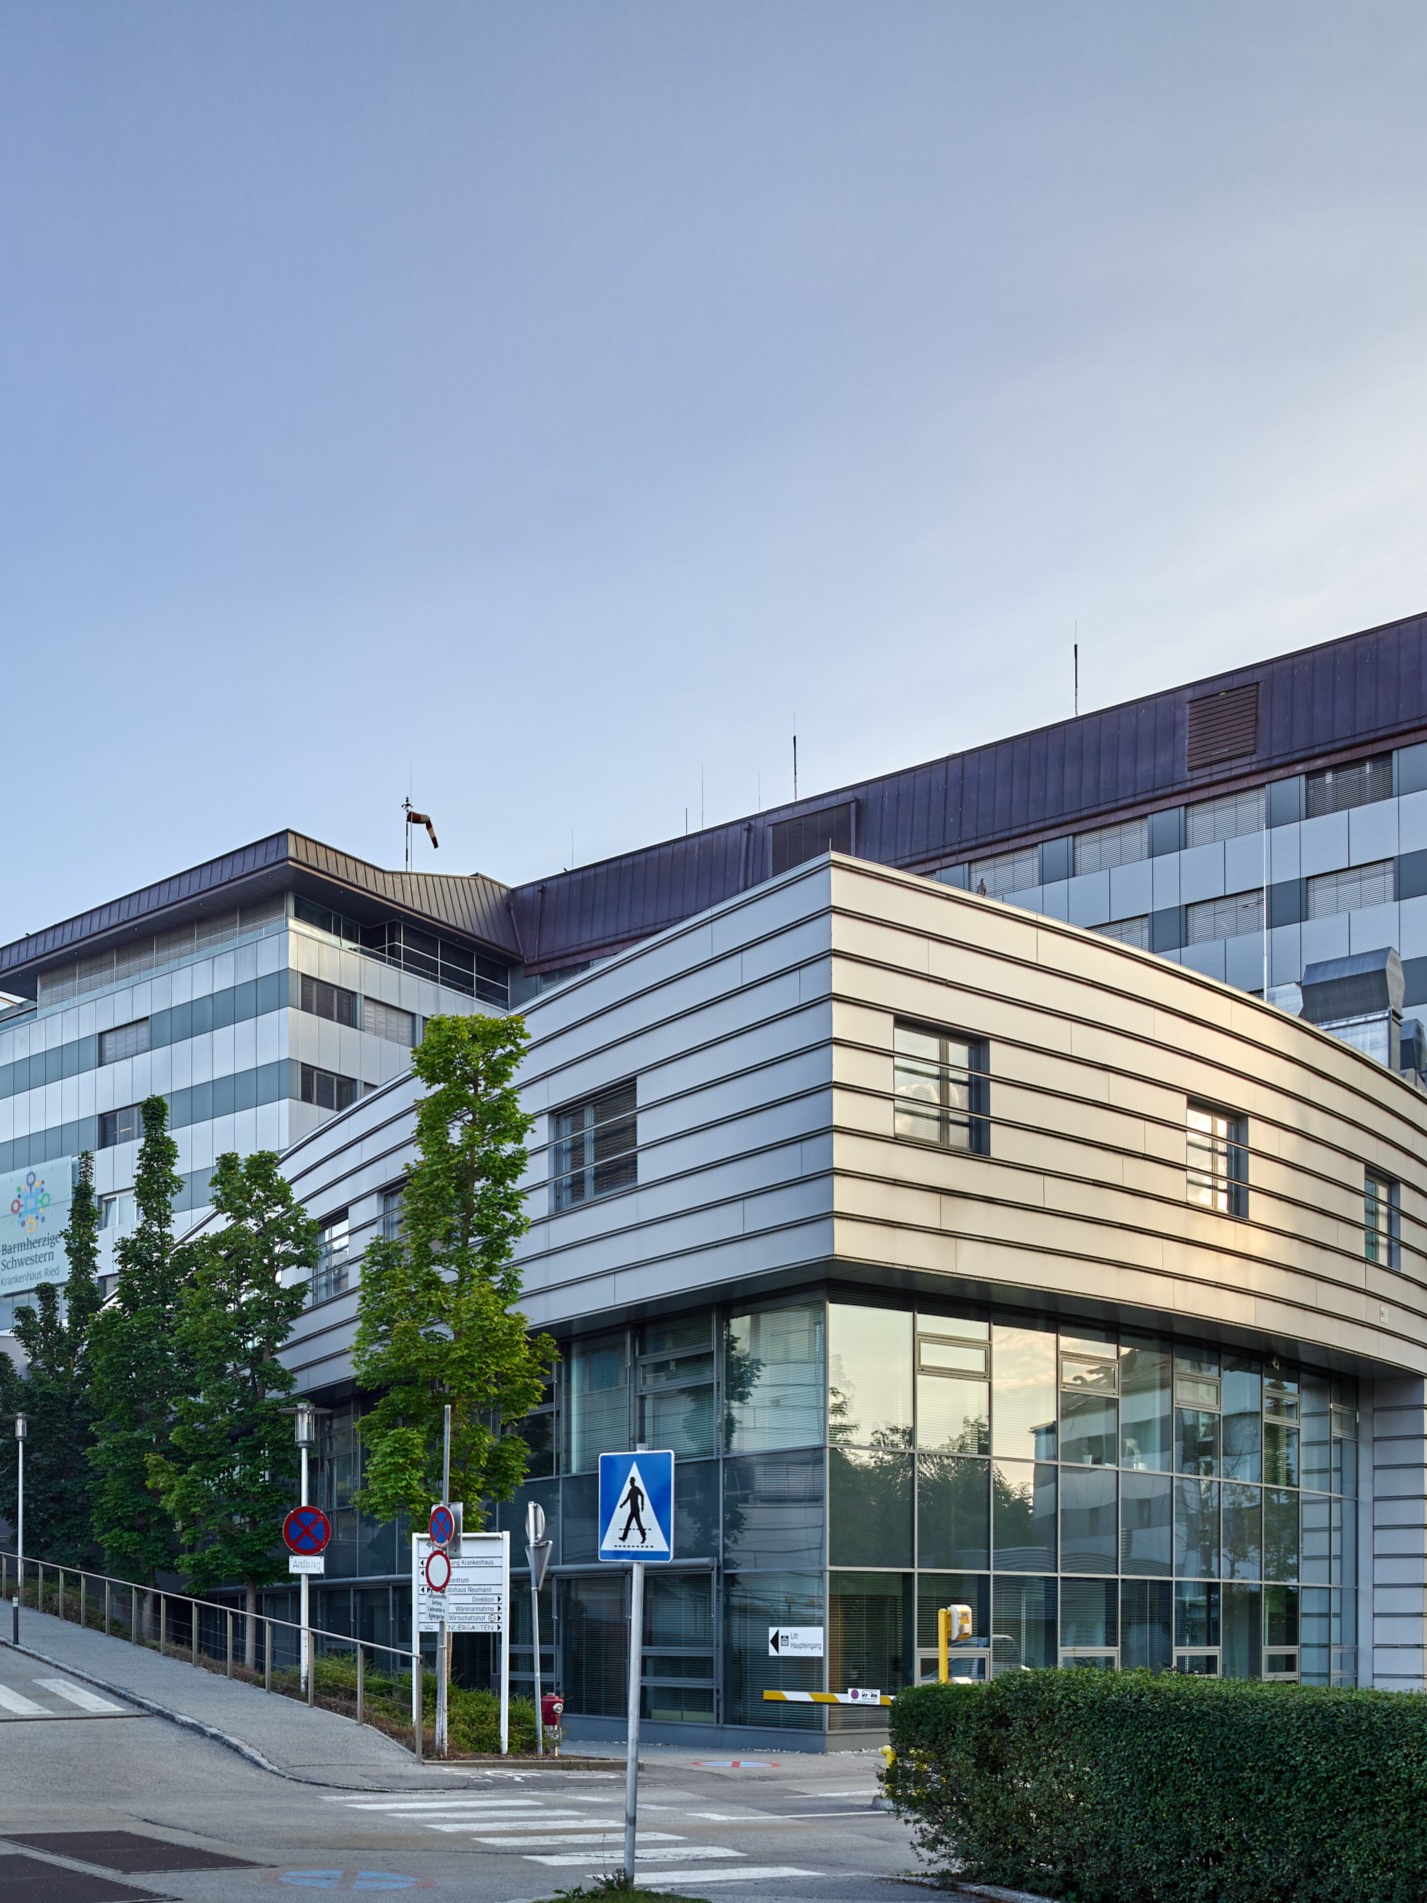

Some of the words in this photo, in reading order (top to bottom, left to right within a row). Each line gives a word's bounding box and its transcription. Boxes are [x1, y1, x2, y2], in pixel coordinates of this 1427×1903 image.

[1, 1232, 61, 1256] Barmherzige
[0, 1251, 54, 1271] Schwestern
[0, 1271, 42, 1286] Krankenhaus
[44, 1266, 60, 1277] Ried
[292, 1560, 321, 1570] Anfang
[790, 1642, 822, 1650] Haupteingang
